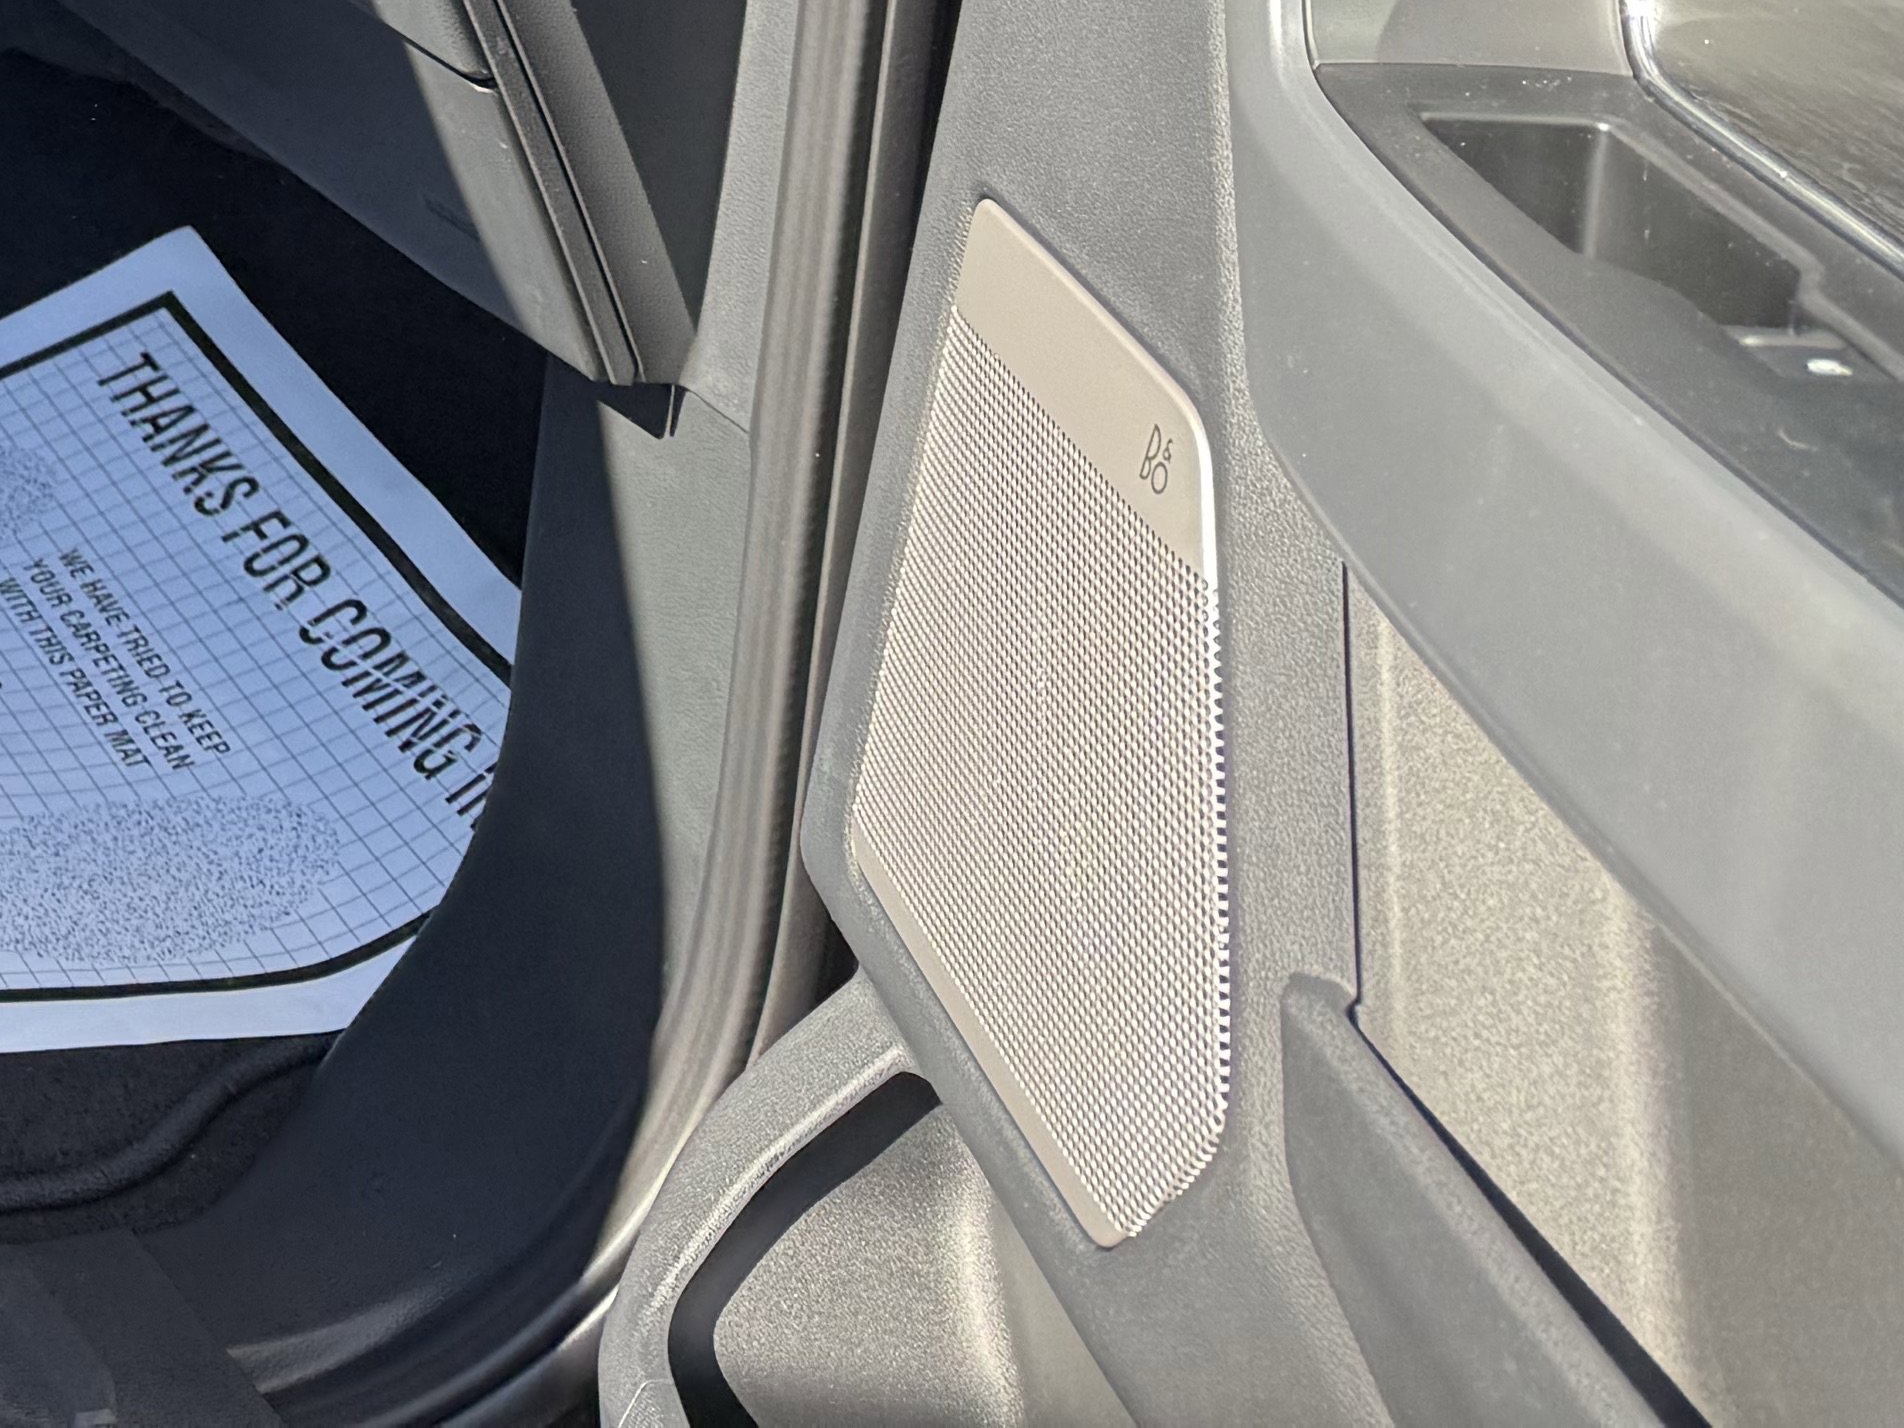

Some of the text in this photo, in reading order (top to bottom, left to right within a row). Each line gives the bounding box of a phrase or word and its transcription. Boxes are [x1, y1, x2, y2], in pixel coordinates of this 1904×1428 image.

[23, 557, 195, 770] YOUR CARPETING CLEAN
[59, 548, 231, 755] WE HAVE TRIED TO KEEP
[98, 351, 261, 517] THANKS
[221, 510, 331, 612] FOR
[299, 598, 482, 781] COMING
[29, 623, 75, 666] THIS
[59, 667, 119, 727] PAPER
[104, 729, 152, 767] MAT
